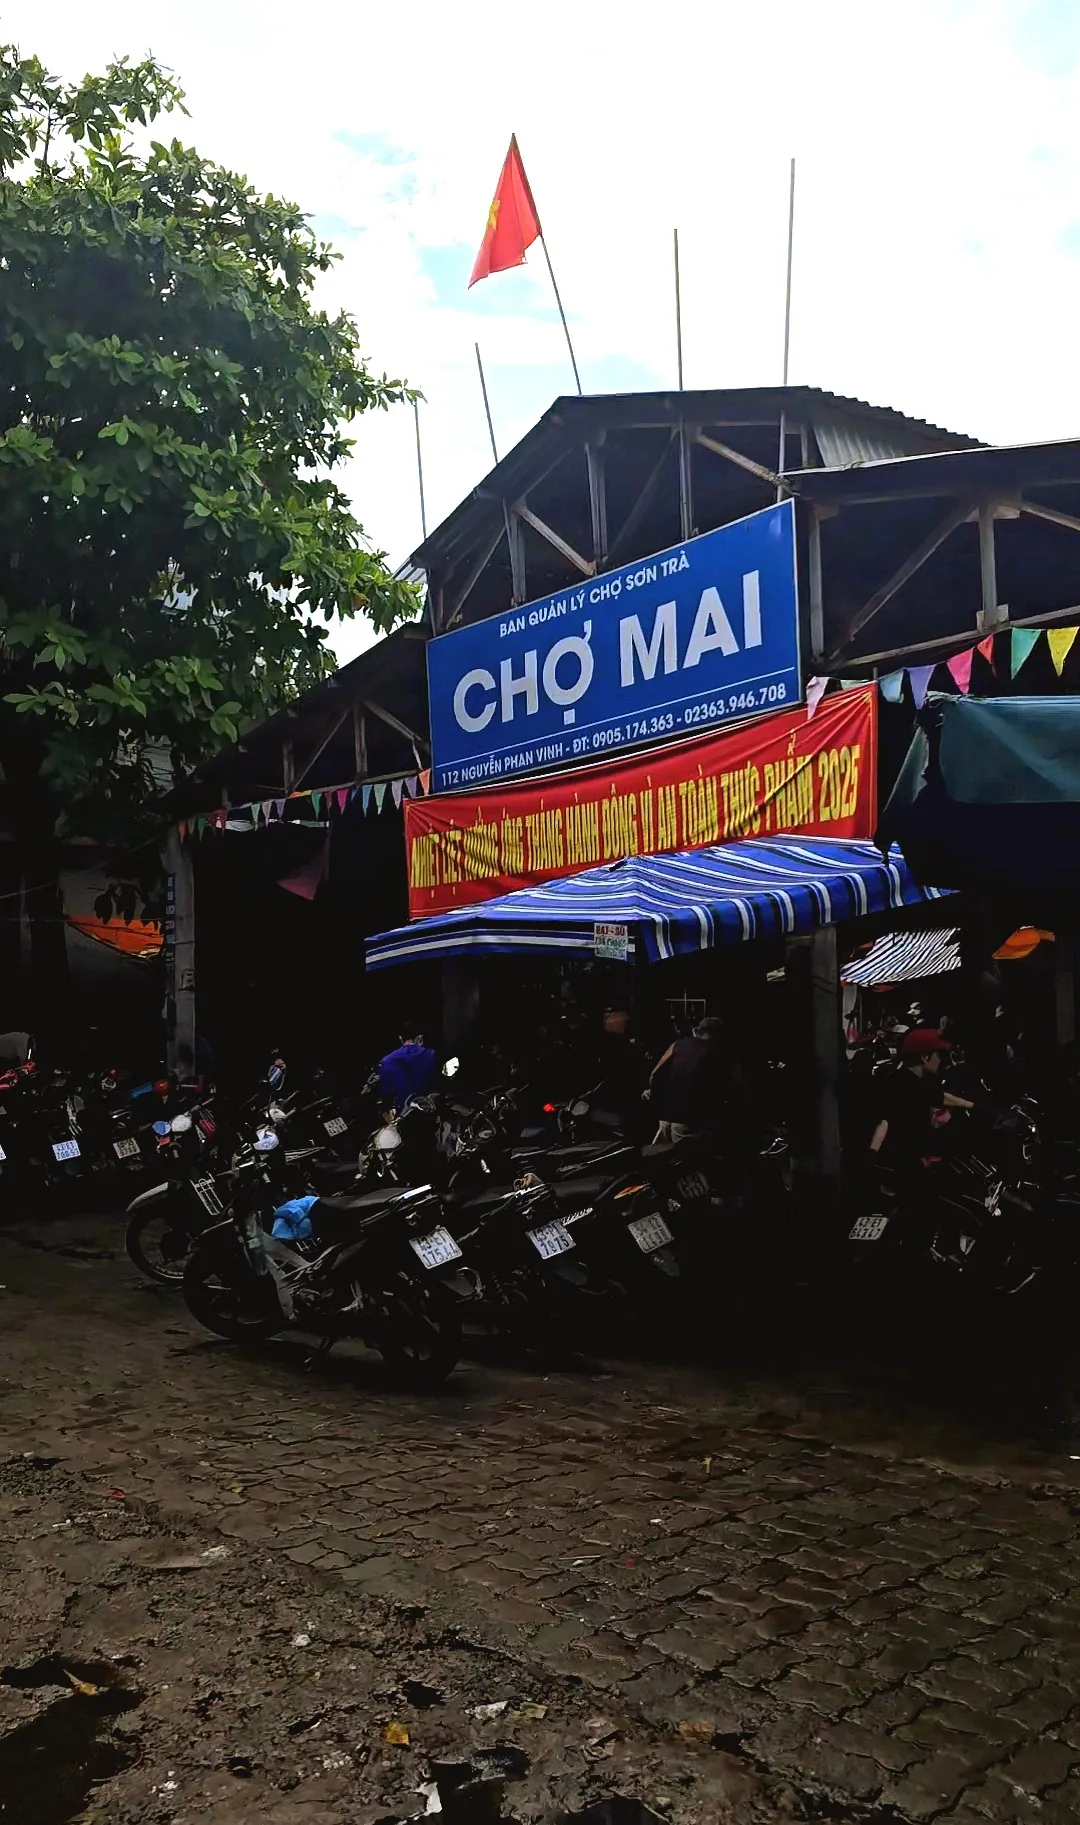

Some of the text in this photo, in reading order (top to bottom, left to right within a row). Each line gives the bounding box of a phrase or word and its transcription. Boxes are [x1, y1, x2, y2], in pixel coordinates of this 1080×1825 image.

[453, 569, 762, 733] CHỢ MAI
[500, 550, 690, 638] BAN QUẢN LÝ CHỢ SƠN TRÀ
[442, 770, 460, 786] 112
[461, 755, 501, 782] NGUYỄN
[504, 754, 534, 772] PHAN
[536, 743, 563, 762] VINH
[572, 735, 590, 754] ĐT:
[592, 715, 673, 748] 0905.174.363
[684, 683, 786, 725] 02363.946.708
[411, 823, 439, 898] NHIỆT
[525, 798, 564, 872] THÁNG
[566, 792, 599, 866] HÀNH
[640, 775, 654, 852] VÌ
[658, 784, 677, 850] AN
[679, 764, 719, 846] TOÀN
[764, 729, 814, 831] PHẨM
[818, 745, 860, 822] 2025
